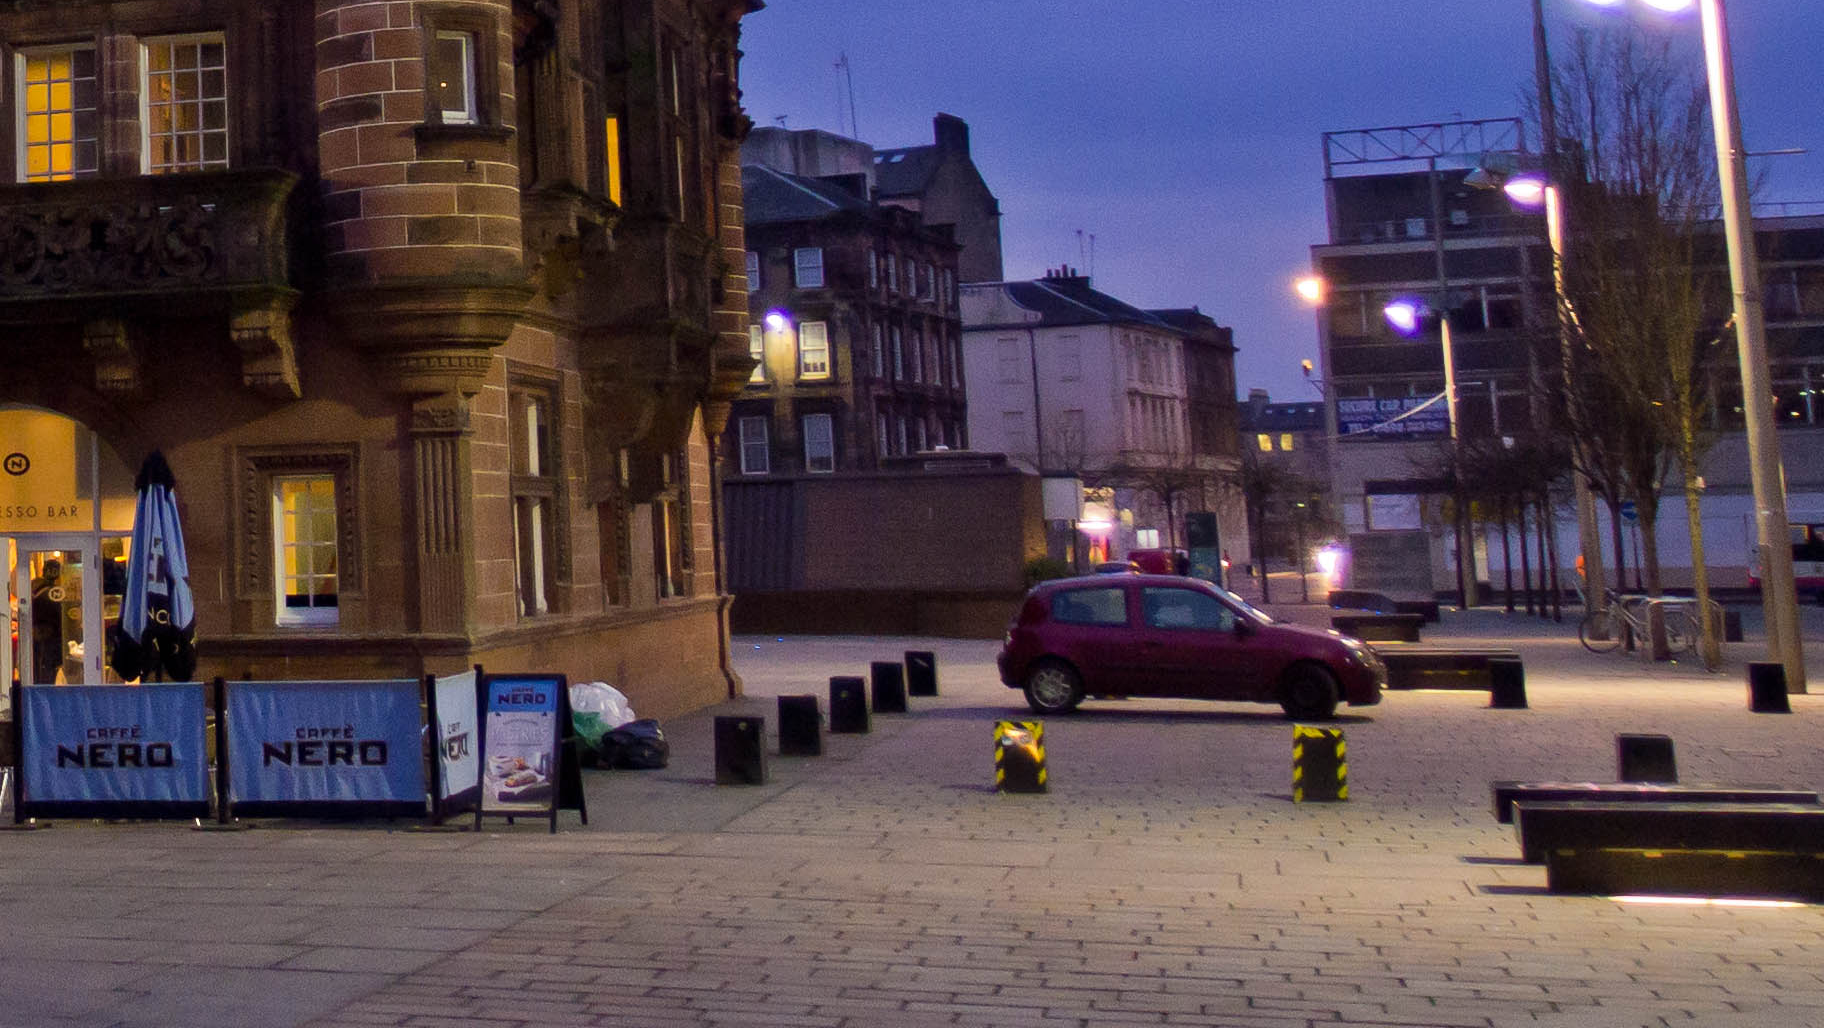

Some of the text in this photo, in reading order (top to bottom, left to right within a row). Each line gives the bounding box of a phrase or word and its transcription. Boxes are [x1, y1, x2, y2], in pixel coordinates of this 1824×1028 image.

[47, 505, 79, 518] BAR
[498, 694, 546, 704] NERO
[57, 741, 174, 768] NERO
[263, 740, 388, 767] NERO
